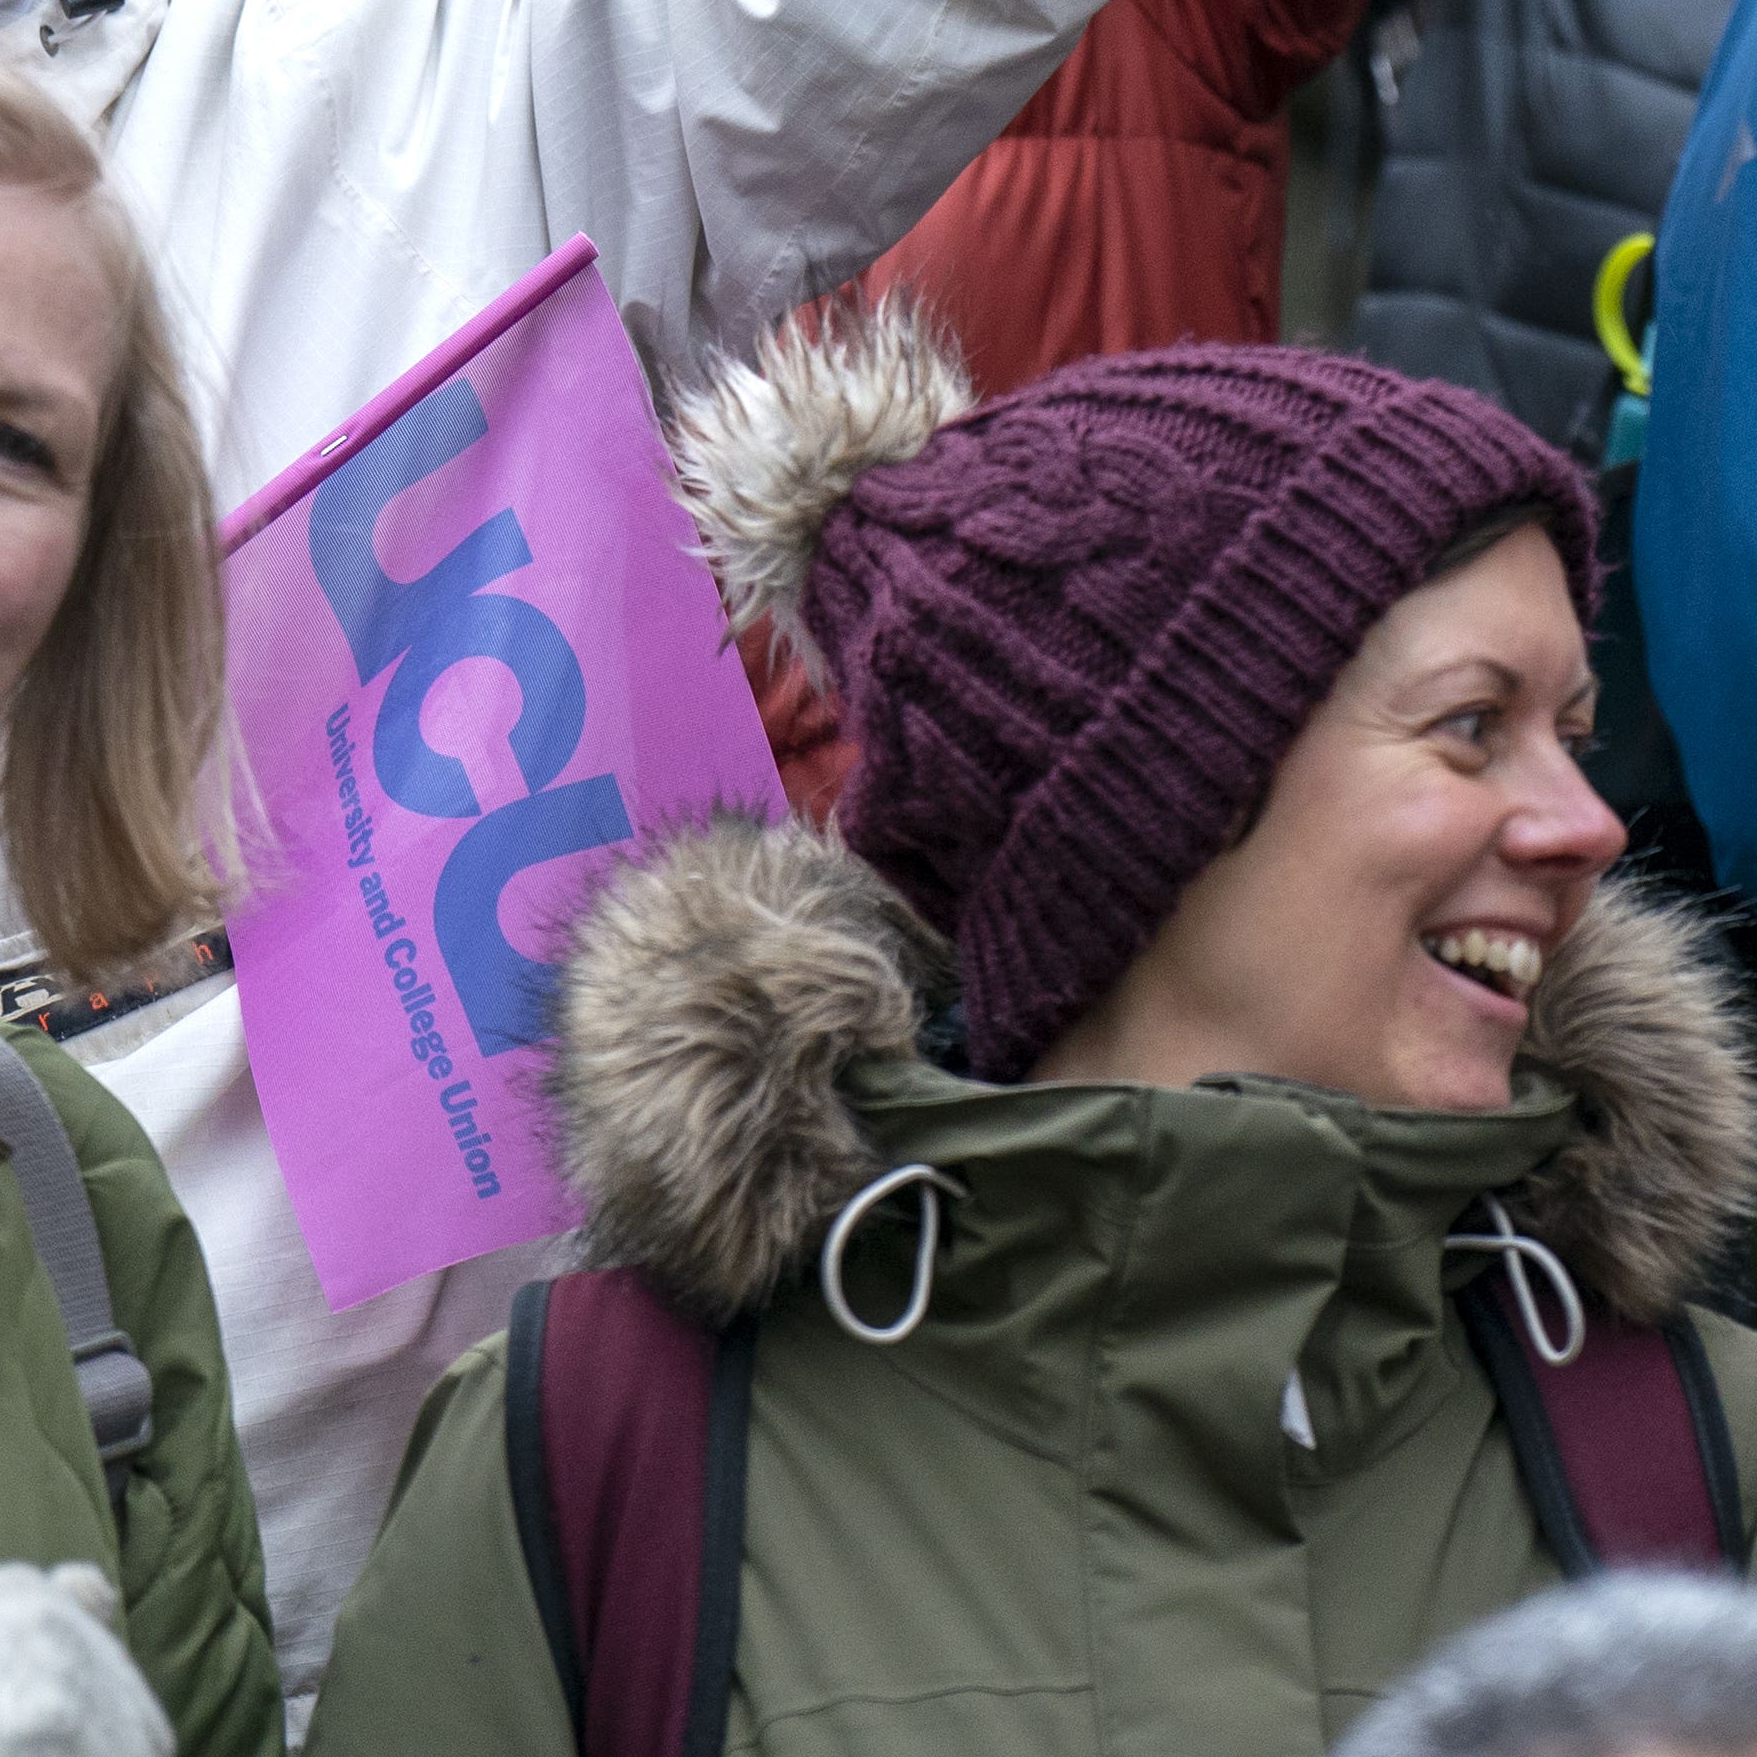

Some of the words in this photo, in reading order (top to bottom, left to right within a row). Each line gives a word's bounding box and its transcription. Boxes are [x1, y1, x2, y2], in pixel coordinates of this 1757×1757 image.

[325, 703, 376, 869] University
[359, 871, 407, 940] and
[384, 938, 454, 1080] College
[439, 1080, 502, 1200] Union
